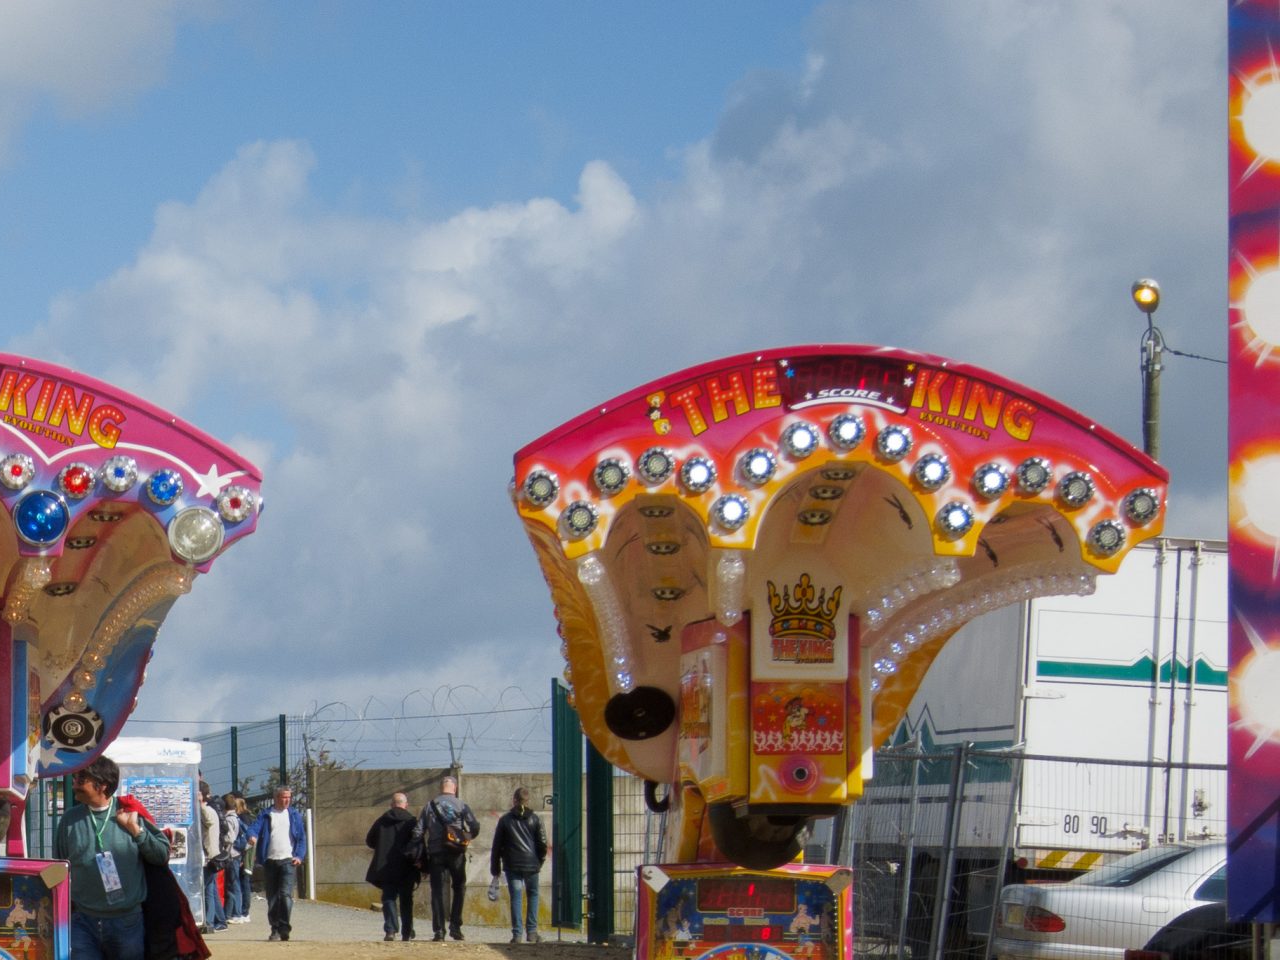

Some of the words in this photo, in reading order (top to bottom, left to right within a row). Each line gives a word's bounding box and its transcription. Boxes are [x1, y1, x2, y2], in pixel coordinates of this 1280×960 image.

[670, 366, 782, 437] THE
[911, 368, 1040, 442] KING
[816, 388, 881, 401] SCORE
[2, 414, 75, 446] EVOLUTION
[919, 411, 991, 441] EVOLUTION
[771, 639, 798, 661] THE
[799, 638, 835, 660] KING
[1063, 814, 1080, 834] 80
[1090, 815, 1108, 836] 90
